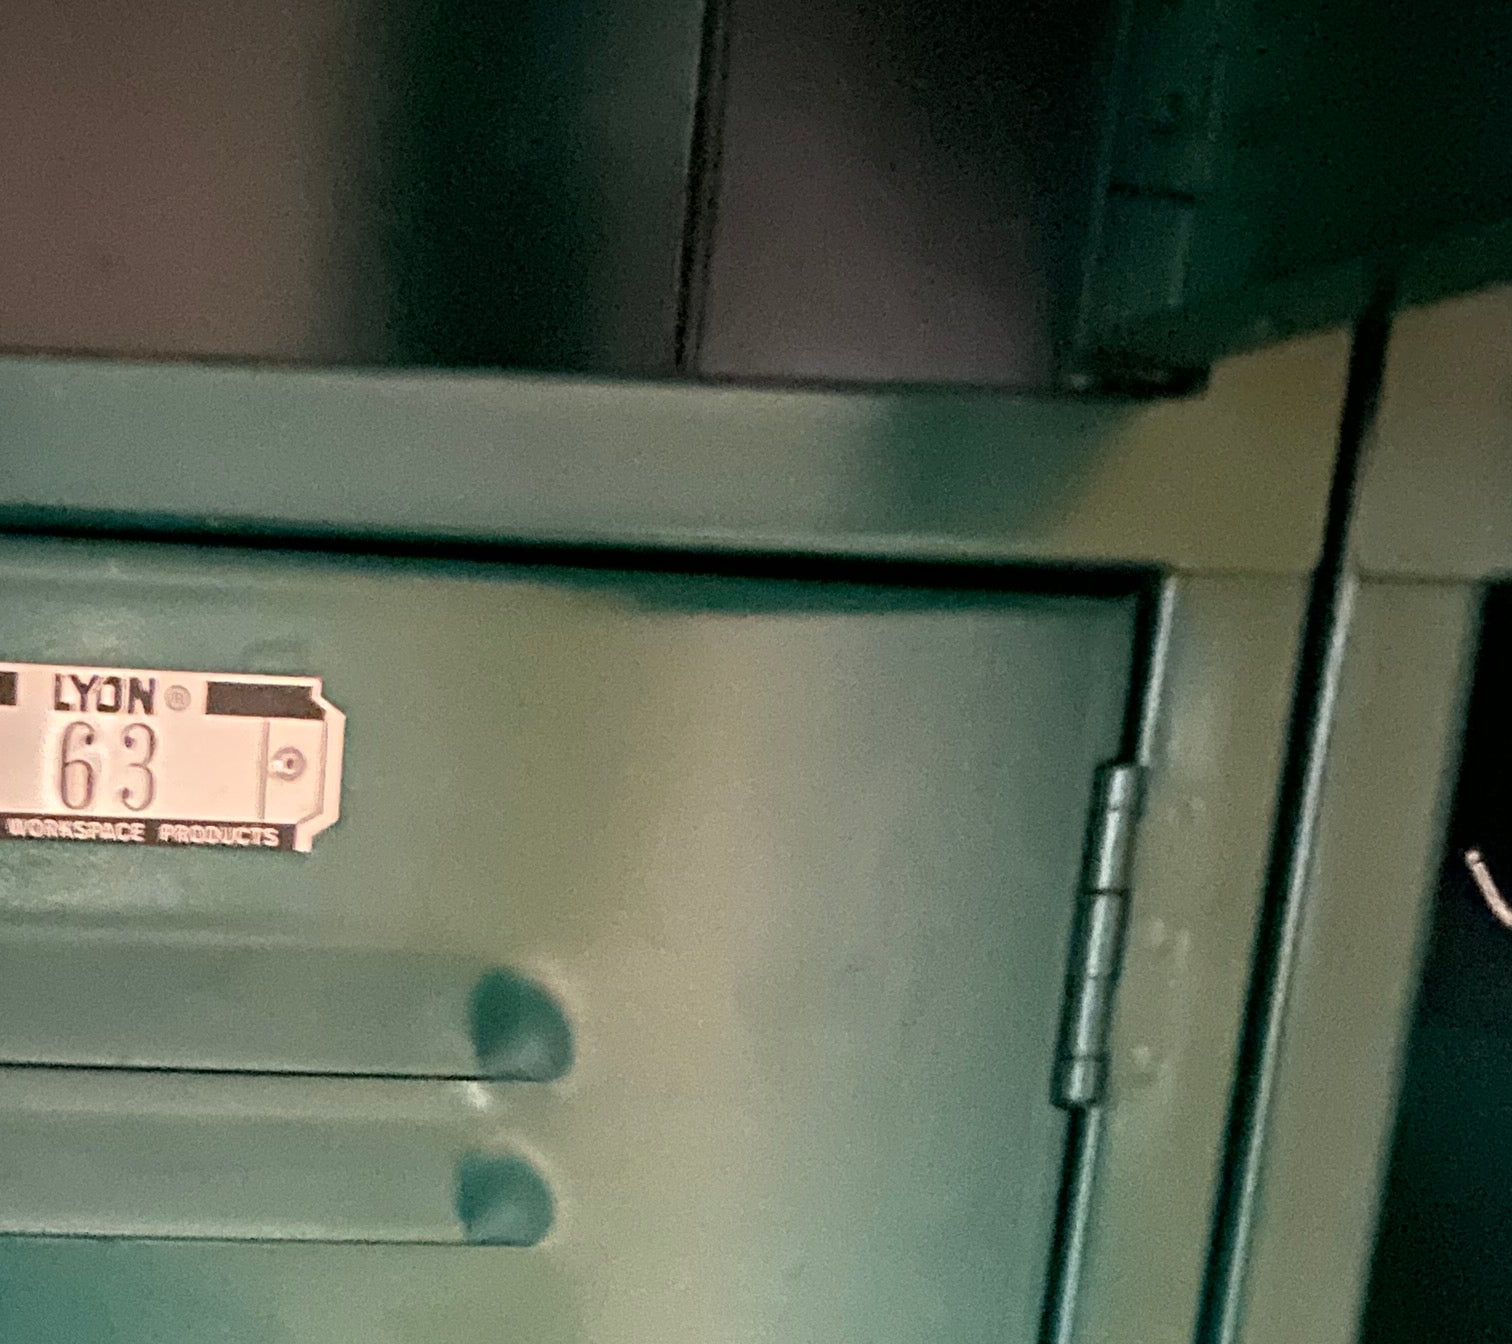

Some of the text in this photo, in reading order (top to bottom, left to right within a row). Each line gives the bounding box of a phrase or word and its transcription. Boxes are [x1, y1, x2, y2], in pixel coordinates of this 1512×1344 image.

[53, 673, 157, 715] LYON
[61, 721, 157, 811] 63
[6, 818, 146, 842] WORKSPACE
[159, 824, 280, 847] PRODUCTS
